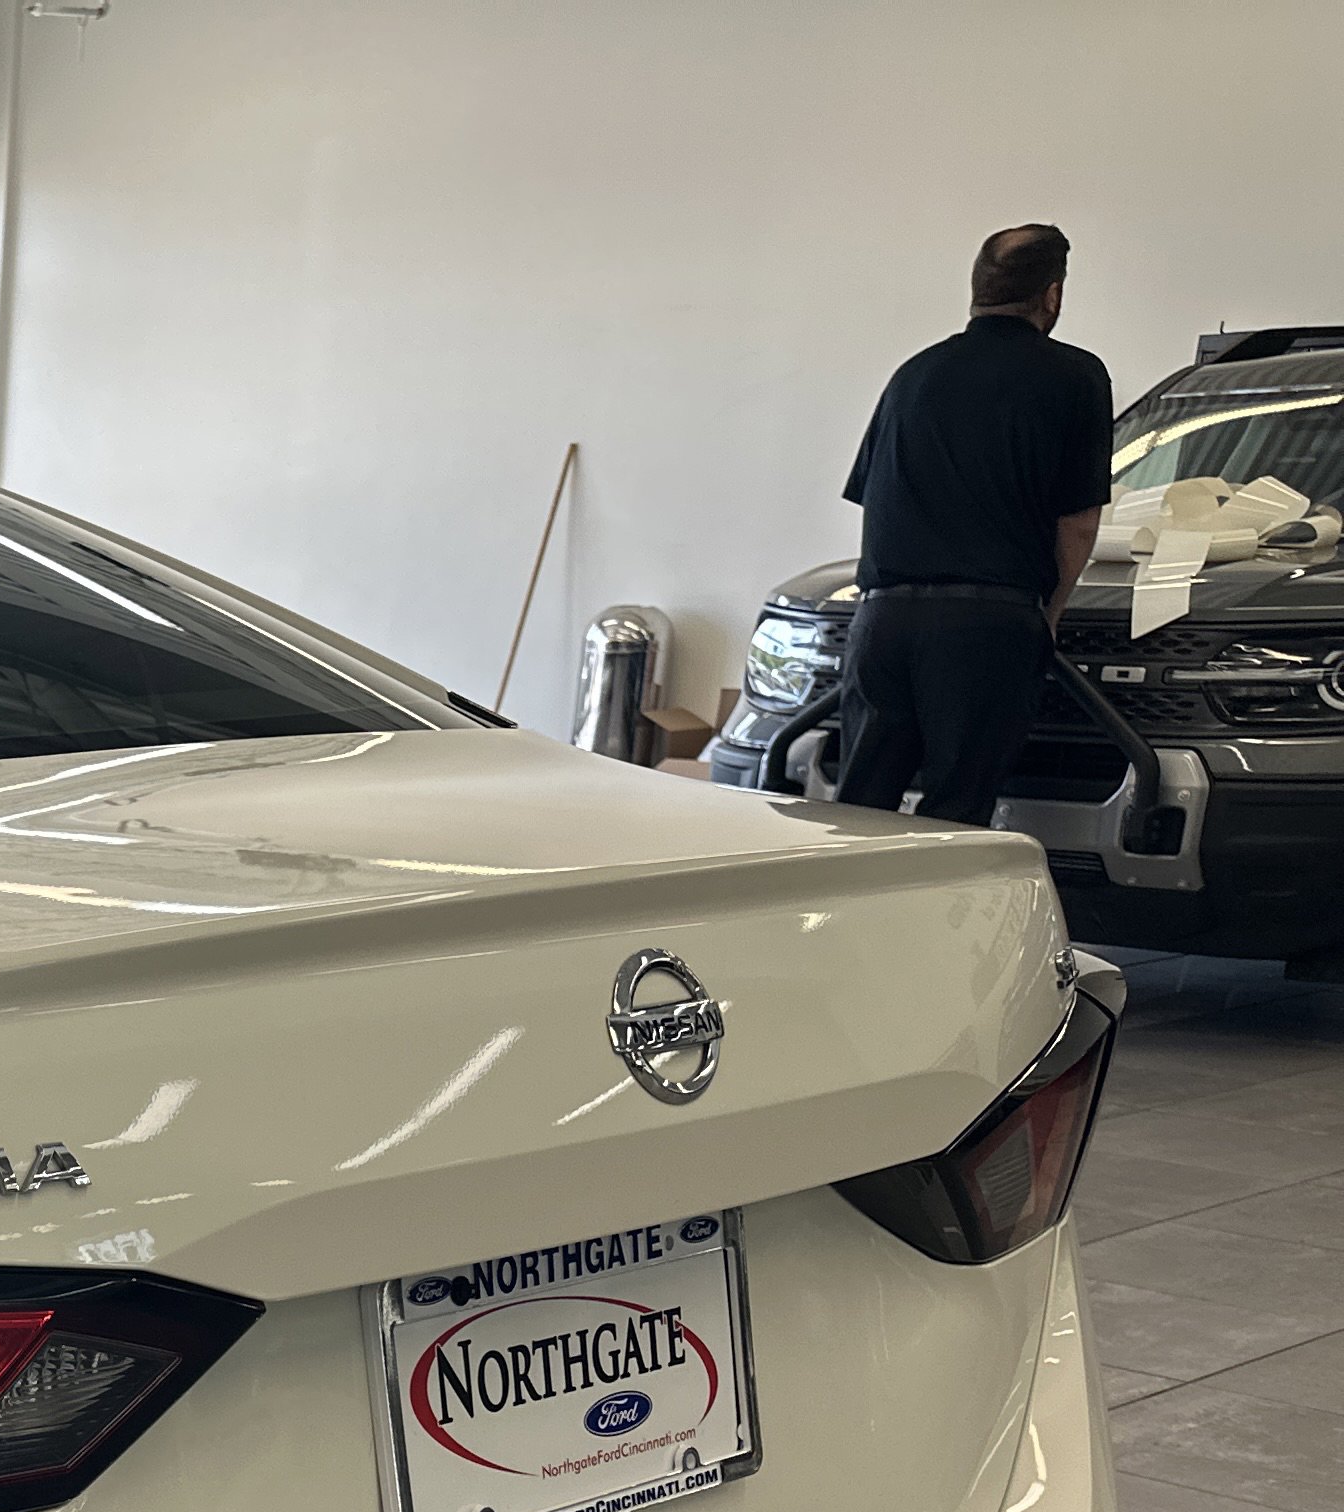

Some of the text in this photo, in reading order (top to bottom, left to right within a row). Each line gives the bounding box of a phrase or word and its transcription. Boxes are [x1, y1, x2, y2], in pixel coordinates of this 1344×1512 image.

[629, 1009, 723, 1043] NISSAN
[471, 1223, 664, 1300] NORTHGATE
[436, 1306, 688, 1427] NORTHGATE
[597, 1397, 640, 1430] Ford
[541, 1427, 696, 1480] NorthgateFordCincinnati.com
